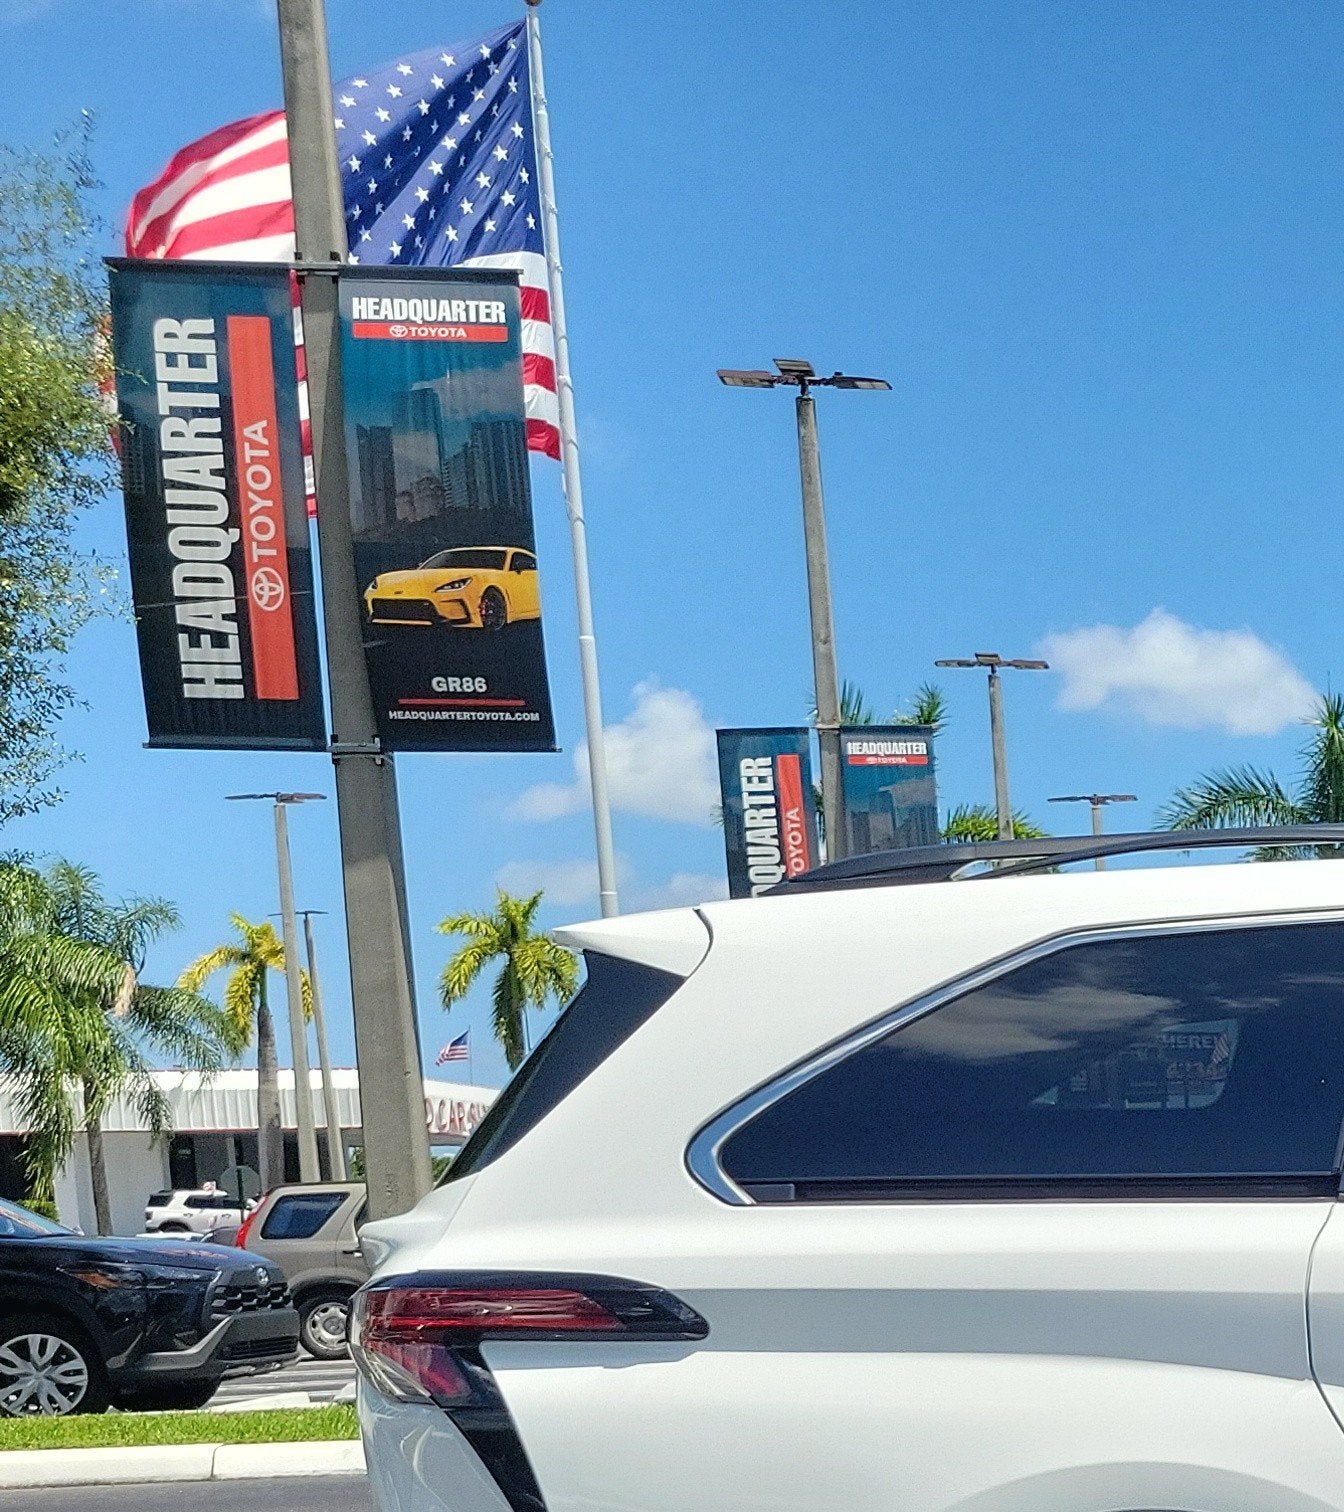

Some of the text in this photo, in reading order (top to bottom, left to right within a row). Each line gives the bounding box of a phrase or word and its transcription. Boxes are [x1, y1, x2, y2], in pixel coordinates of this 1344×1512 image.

[352, 297, 505, 324] HEADQUARTER
[410, 327, 467, 338] TOYOTA
[245, 419, 279, 562] TOYOTA
[153, 317, 246, 700] HEADQUARTER
[431, 676, 487, 692] GR86
[388, 710, 540, 721] HEADQUARTERTOYOTA.COM
[847, 742, 927, 756] HEADQUARTER
[740, 757, 787, 898] QUARTER
[787, 807, 805, 878] OYOTA
